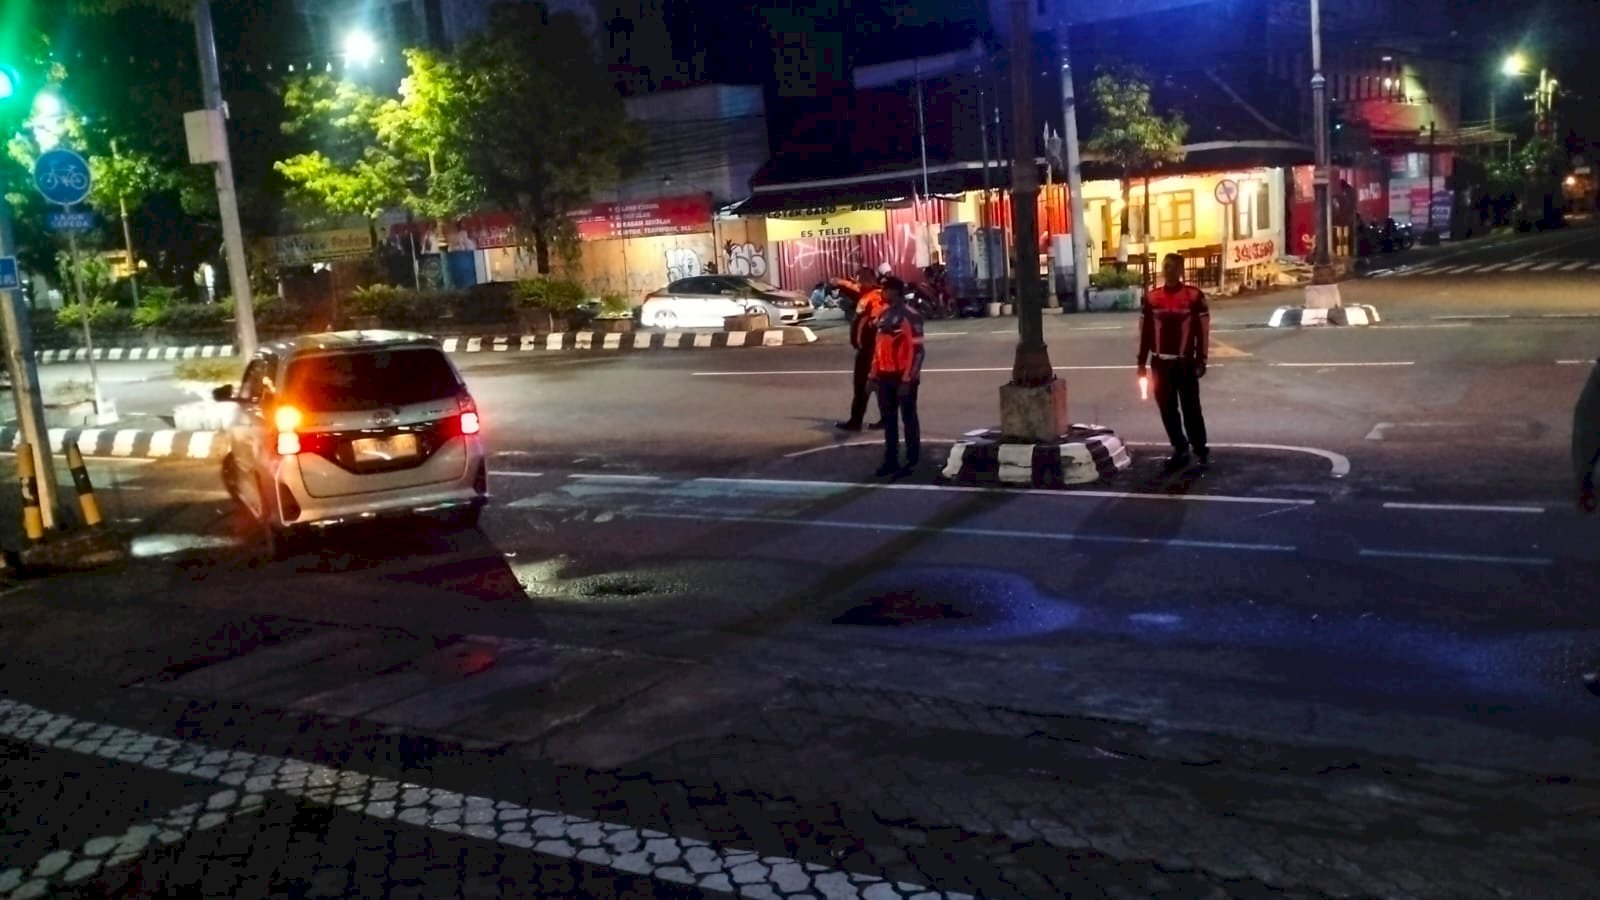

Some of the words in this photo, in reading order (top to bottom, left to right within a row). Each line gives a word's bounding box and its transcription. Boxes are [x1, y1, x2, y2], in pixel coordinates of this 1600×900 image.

[820, 218, 829, 226] &
[800, 230, 814, 238] ES
[819, 227, 851, 237] TELER
